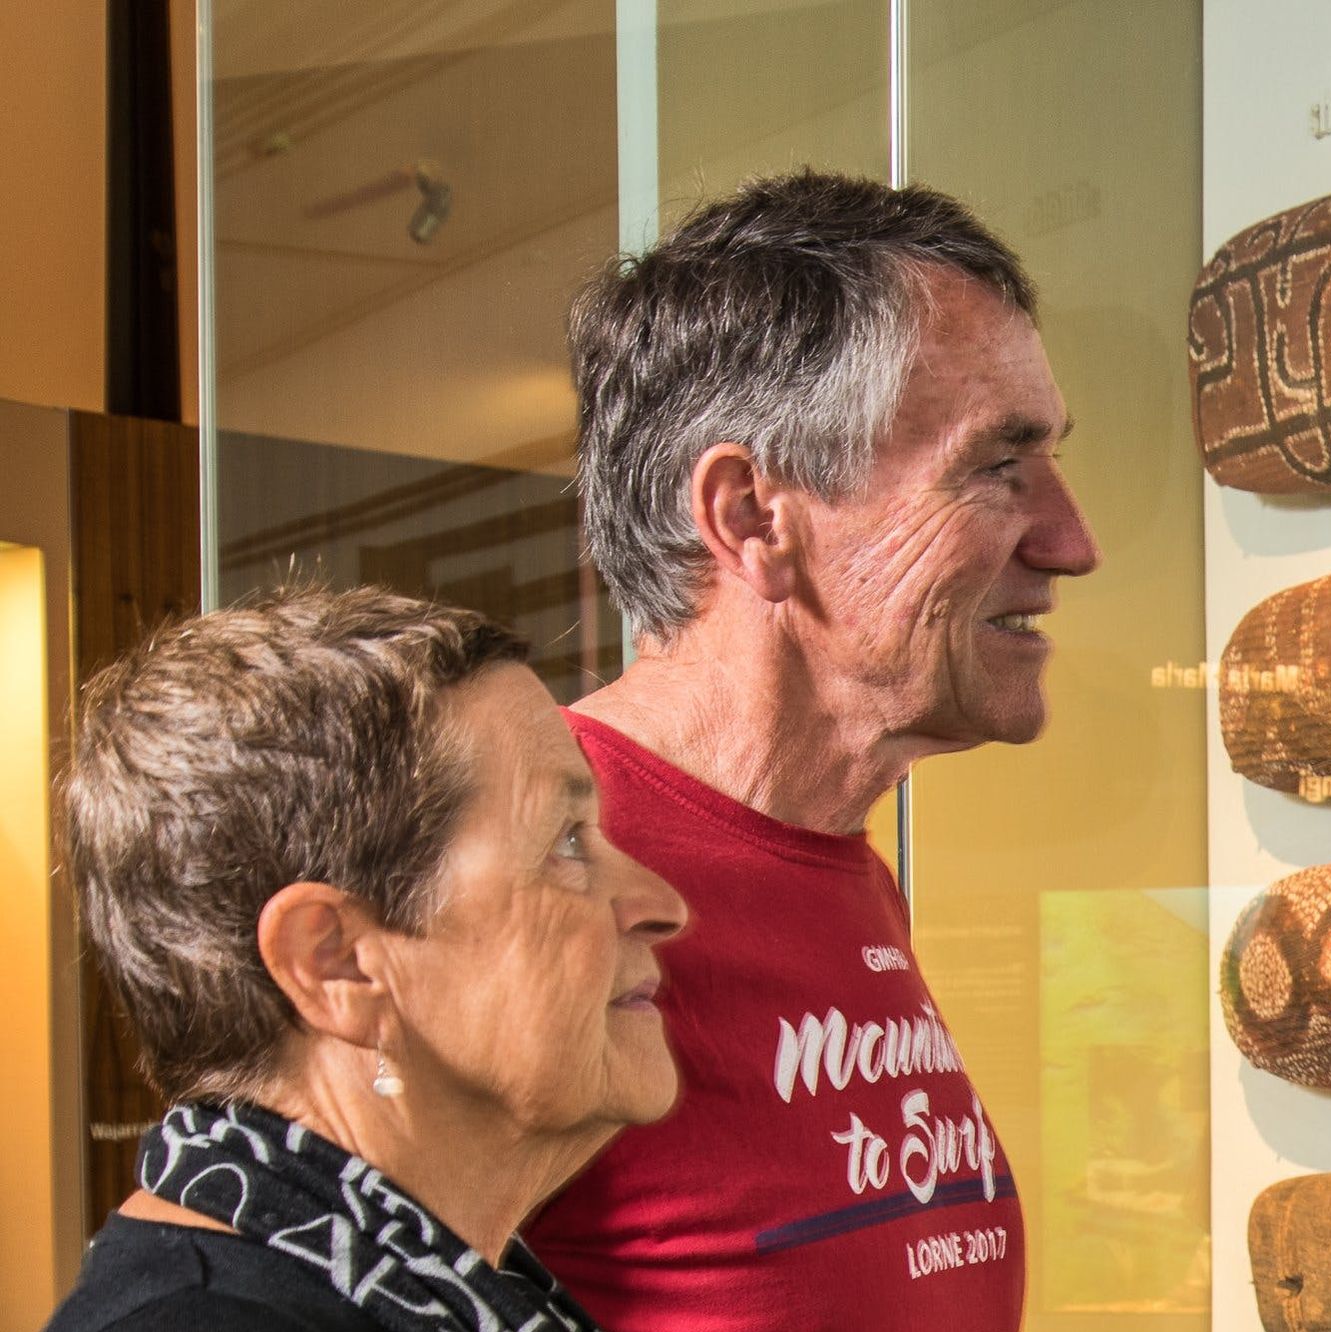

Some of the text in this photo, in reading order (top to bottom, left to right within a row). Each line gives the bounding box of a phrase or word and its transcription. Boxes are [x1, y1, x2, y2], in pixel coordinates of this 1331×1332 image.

[831, 1088, 997, 1204] to Surf
[906, 1226, 1008, 1280] LORNE 2017
